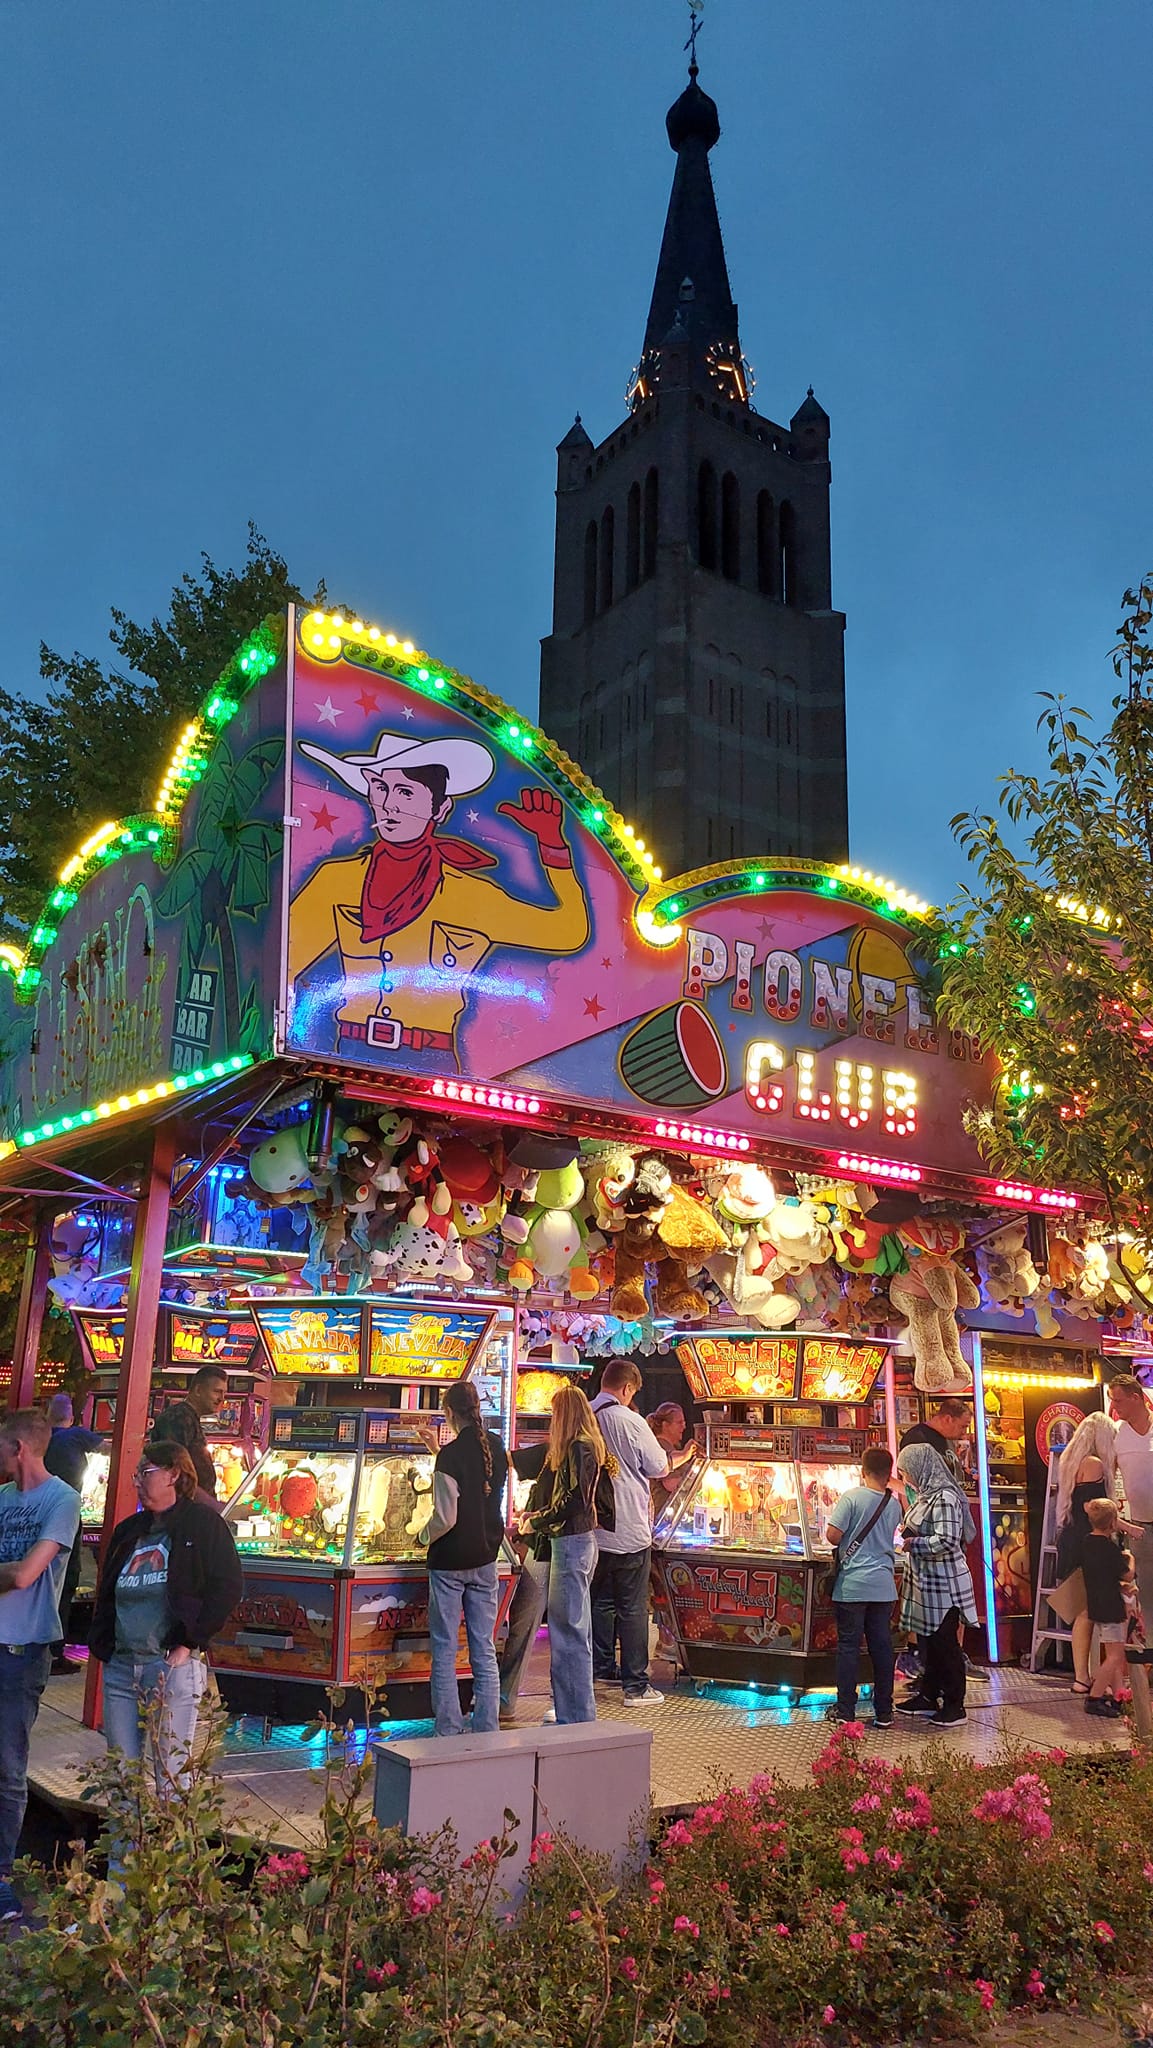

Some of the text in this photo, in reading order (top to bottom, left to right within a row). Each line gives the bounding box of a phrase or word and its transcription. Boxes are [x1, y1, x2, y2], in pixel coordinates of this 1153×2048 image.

[188, 972, 212, 1003] AR
[175, 1006, 208, 1040] BAR
[745, 1041, 917, 1138] CLUB
[290, 1310, 328, 1327] Super
[405, 1313, 452, 1330] Super
[273, 1330, 354, 1354] NEVADA
[381, 1332, 466, 1359] NEVADA
[717, 1342, 780, 1377] 777
[823, 1345, 873, 1383] 777
[1042, 1405, 1083, 1423] CHANGE
[118, 1571, 168, 1588] GOOD VIBES
[695, 1567, 777, 1620] 777
